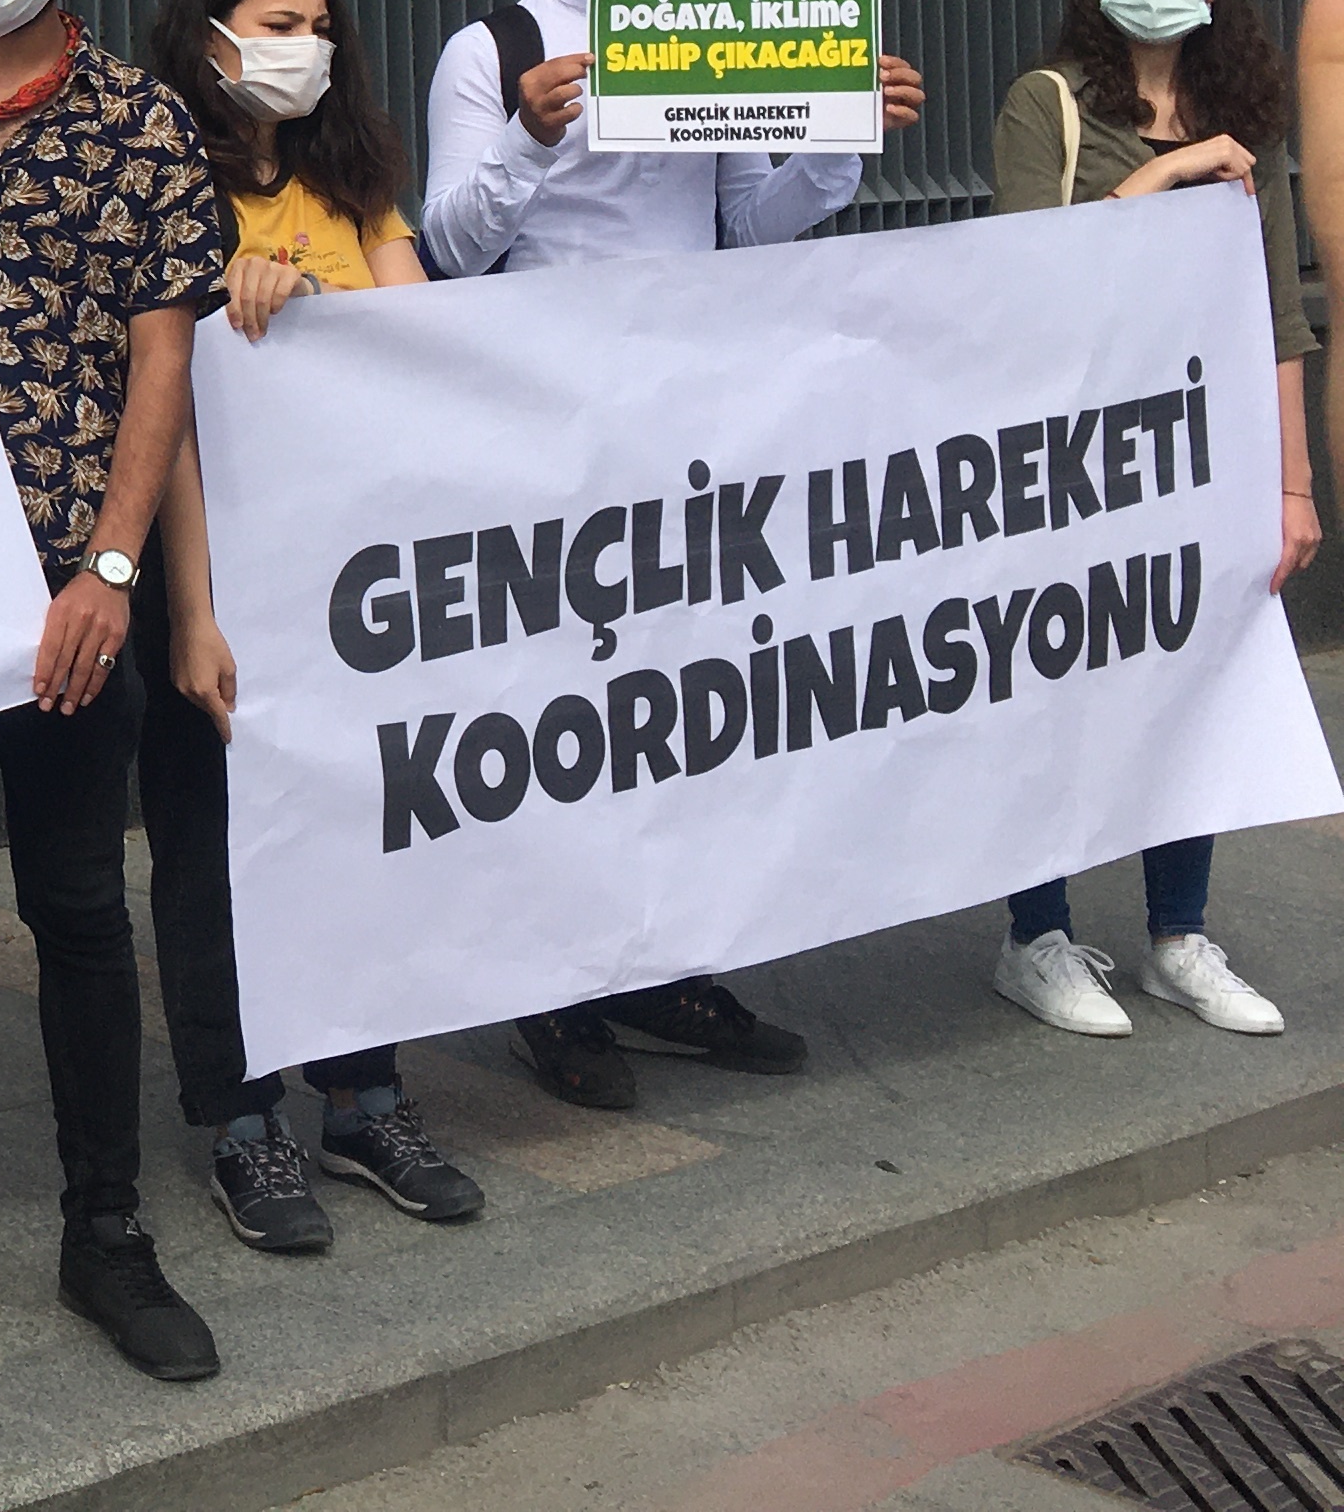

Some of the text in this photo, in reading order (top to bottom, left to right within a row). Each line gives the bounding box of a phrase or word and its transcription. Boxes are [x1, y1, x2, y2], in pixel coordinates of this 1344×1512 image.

[606, 31, 869, 79] SAHİP ÇIKACAĞIZ
[664, 101, 810, 125] GENÇLİK HAREKETİ
[669, 123, 807, 143] KOORDİNASYONU
[328, 356, 1212, 674] GENÇLİK HAREKETİ
[377, 542, 1202, 854] KOORDİNASYONU
